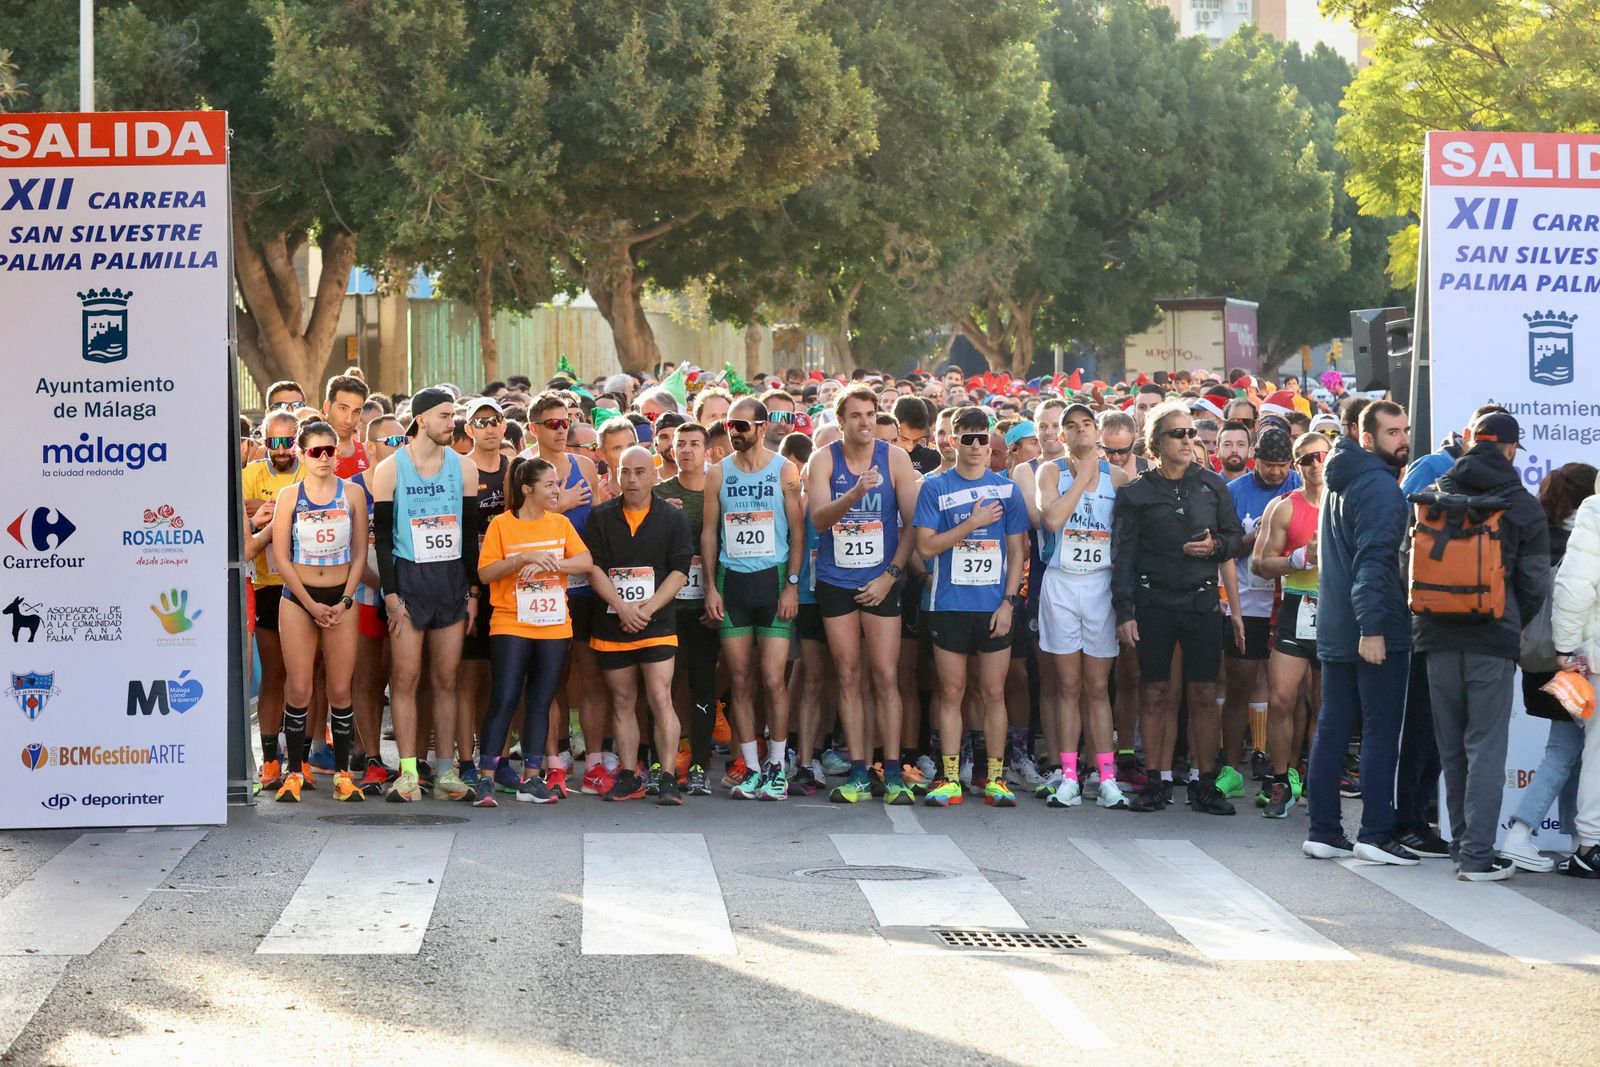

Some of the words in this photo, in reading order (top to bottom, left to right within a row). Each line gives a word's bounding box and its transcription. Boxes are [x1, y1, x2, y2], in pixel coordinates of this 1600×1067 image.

[0, 121, 213, 159] SALIDA
[1, 178, 74, 210] XII
[88, 191, 207, 209] CARRERA
[1446, 197, 1519, 230] XII
[9, 226, 63, 243] SAN
[70, 223, 202, 243] SILVESTRE
[91, 251, 218, 270] PALMILLA
[1456, 245, 1508, 263] SAN
[1516, 246, 1599, 265] SILVES
[1439, 273, 1527, 291] PALMA
[36, 377, 174, 397] Ayuntamiento
[54, 403, 77, 418] de
[84, 401, 156, 420] Málaga
[1533, 423, 1600, 445] Málaga
[42, 469, 50, 477] la
[53, 469, 84, 477] ciudad
[86, 468, 124, 476] redonda
[406, 482, 446, 497] nerja
[726, 480, 775, 499] nerja
[122, 529, 205, 546] ROSALEDA
[315, 528, 336, 543] 65
[425, 534, 453, 550] 565
[736, 530, 765, 545] 420
[845, 541, 874, 556] 215
[1072, 547, 1102, 563] 216
[3, 554, 86, 570] Carrefour
[135, 556, 159, 566] desde
[160, 557, 189, 566] siempre
[963, 558, 993, 573] 379
[109, 605, 121, 614] DE
[529, 598, 558, 613] 432
[46, 621, 54, 629] A
[72, 620, 122, 628] COMUNIDAD
[46, 634, 74, 642] PALMA
[84, 633, 122, 641] PALMILLA
[82, 793, 165, 808] deporinter
